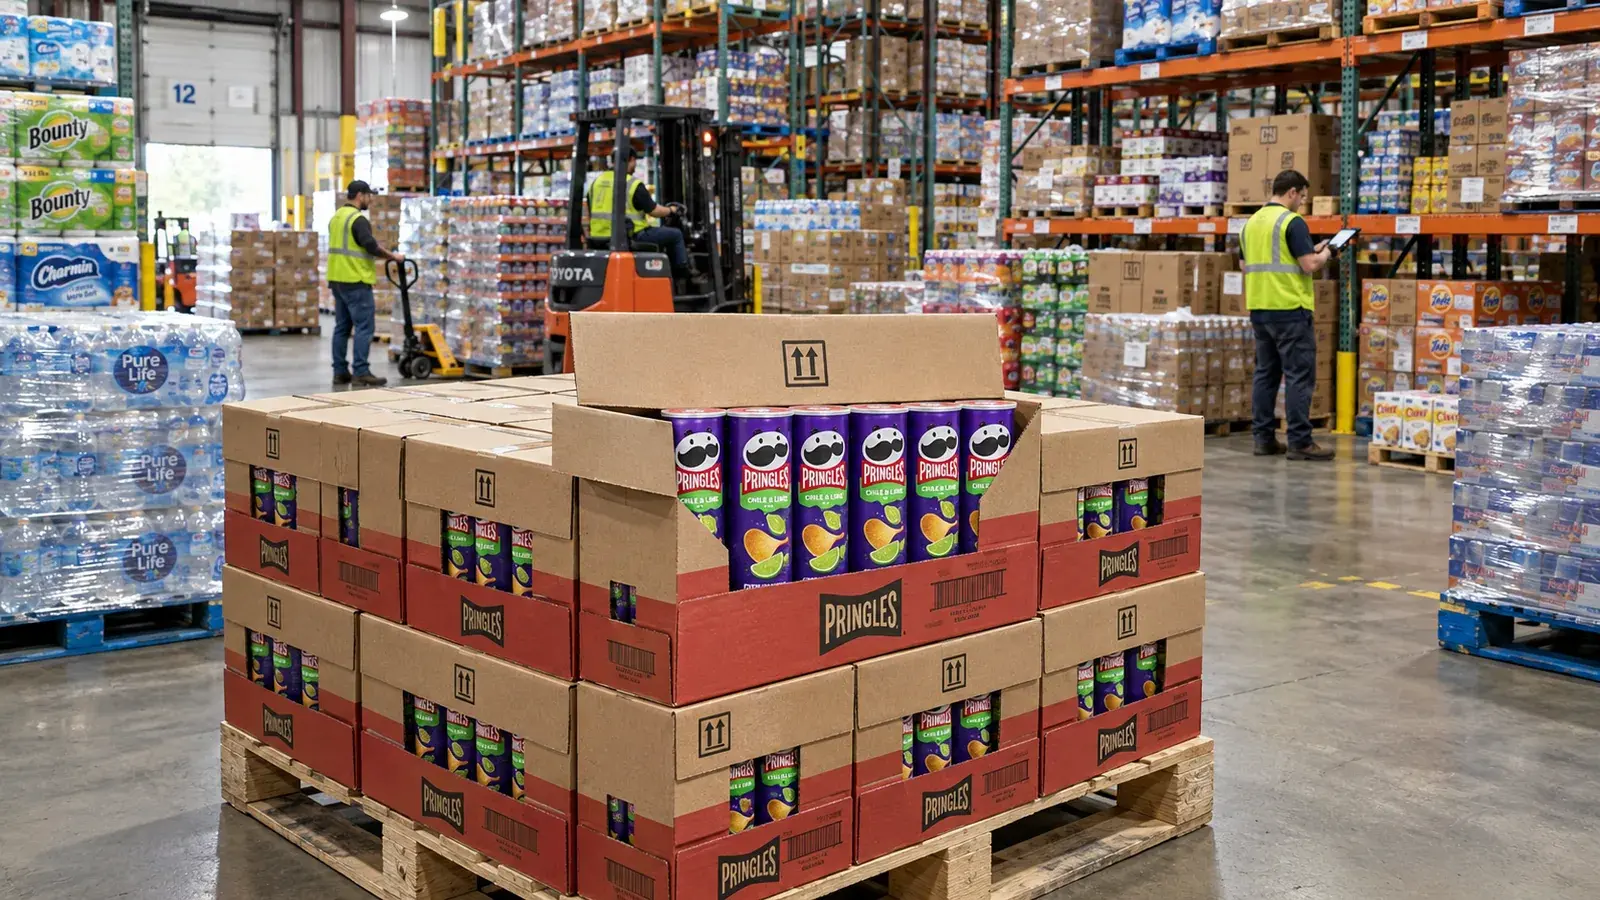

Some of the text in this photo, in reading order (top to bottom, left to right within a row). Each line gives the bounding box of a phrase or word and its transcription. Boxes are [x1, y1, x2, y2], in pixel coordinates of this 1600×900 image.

[173, 84, 196, 104] 12
[29, 118, 88, 149] Bounty
[31, 189, 91, 220] Bounty
[38, 260, 93, 285] Charmin
[122, 354, 160, 368] Pure
[128, 367, 156, 381] Life
[141, 454, 178, 469] Pure
[147, 467, 174, 481] Life
[863, 460, 904, 485] PRINGLES
[919, 457, 958, 480] PRINGLES
[744, 467, 789, 493] PRINGLES
[802, 465, 845, 489] PRINGLES
[132, 542, 169, 557] Pure
[261, 540, 288, 568] PRINGLES
[138, 556, 165, 570] Life
[1101, 548, 1137, 580] PRINGLES
[464, 603, 502, 640] PRINGLES
[825, 590, 897, 644] PRINGLES
[264, 709, 291, 743] PRINGLES
[1100, 721, 1134, 760] PRINGLES
[424, 784, 461, 826] PRINGLES
[925, 782, 969, 825] PRINGLES
[722, 845, 776, 894] PRINGLES
